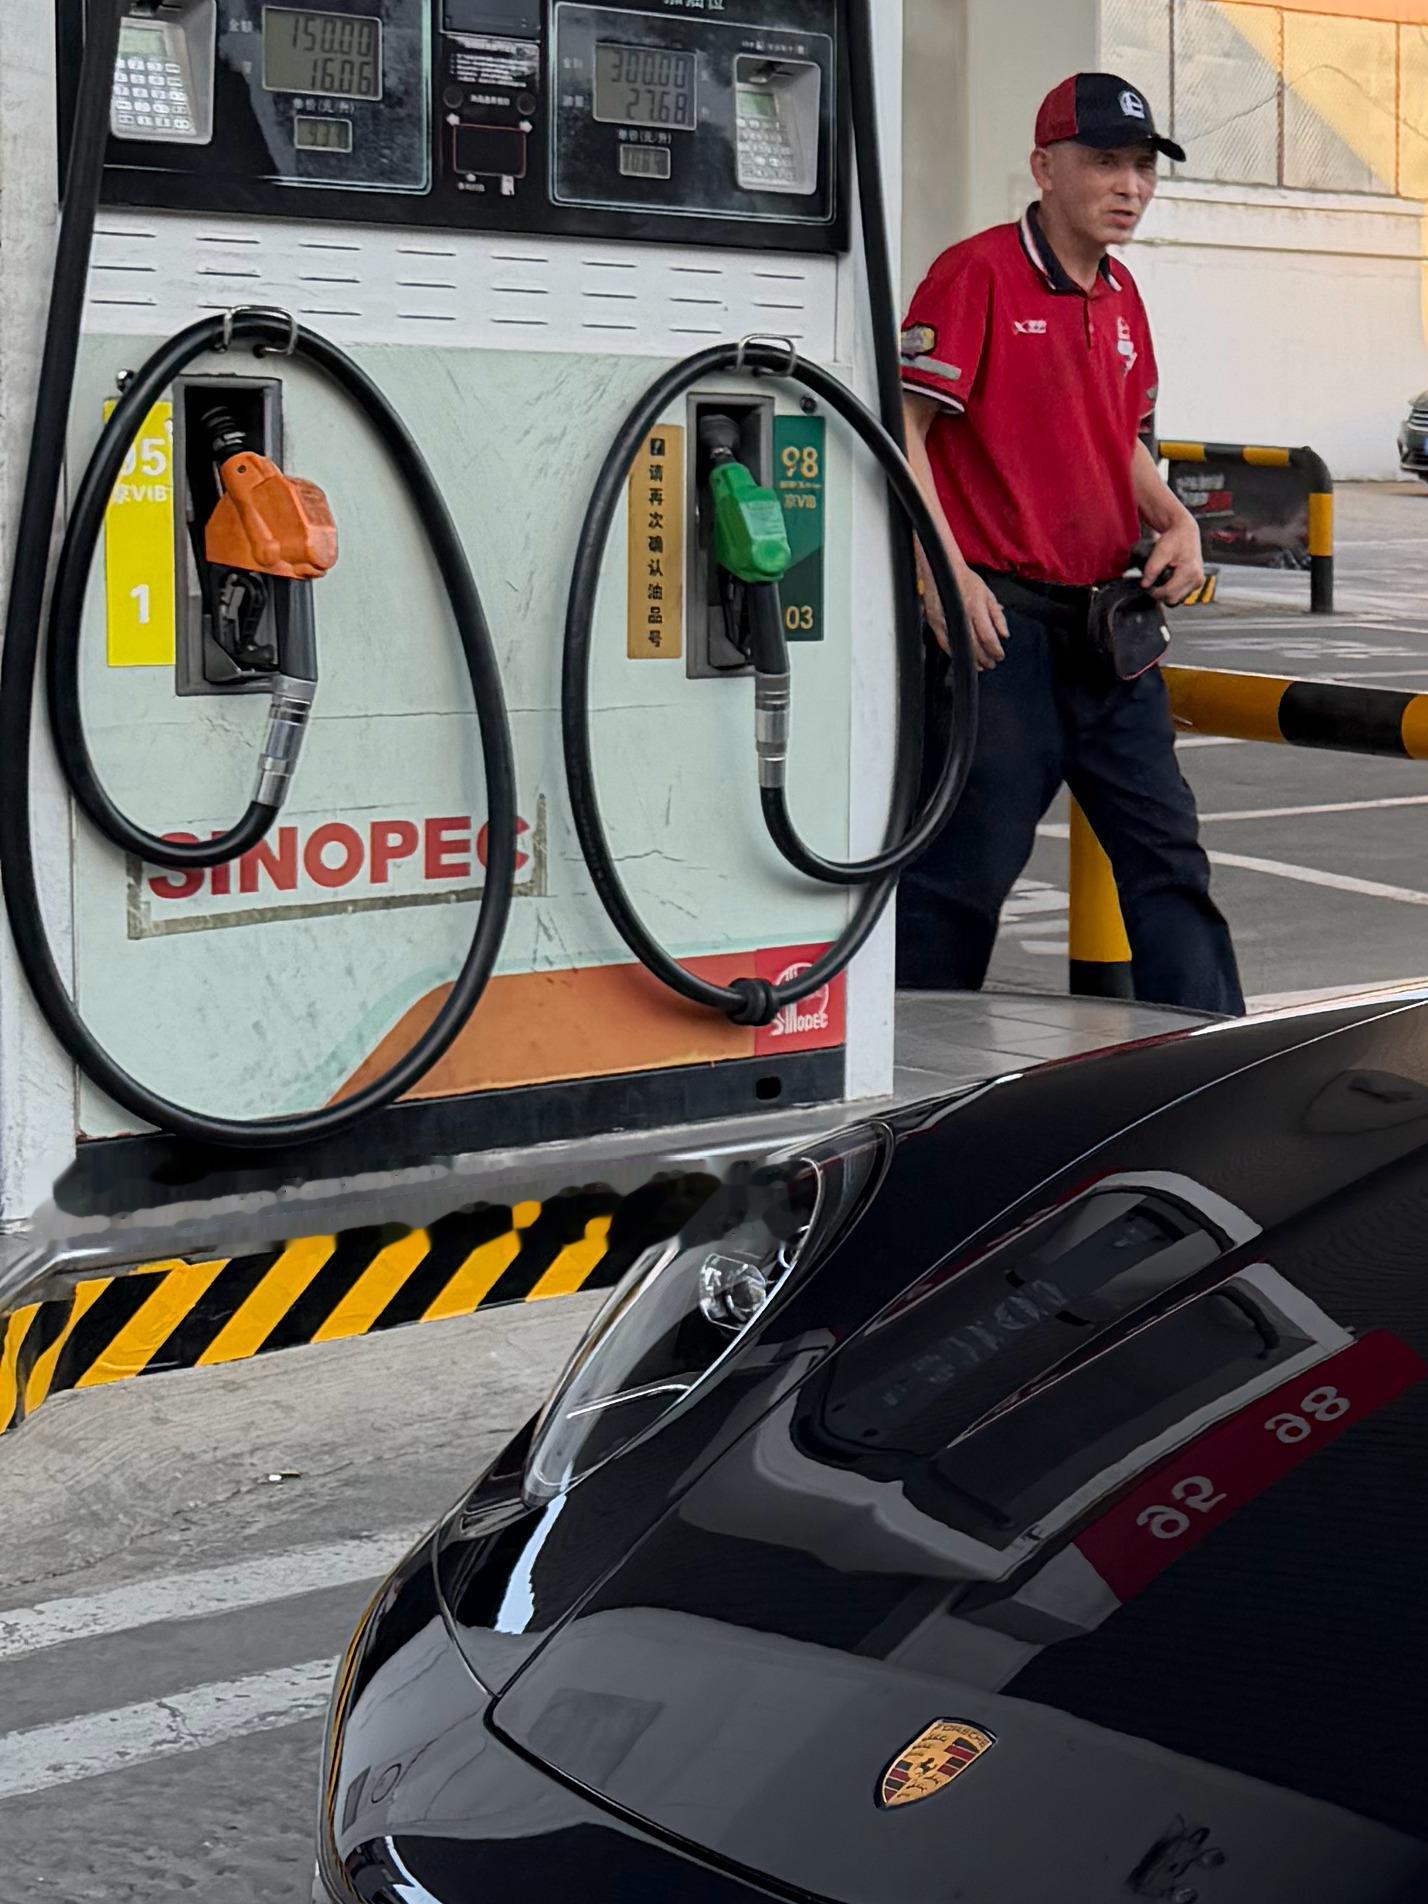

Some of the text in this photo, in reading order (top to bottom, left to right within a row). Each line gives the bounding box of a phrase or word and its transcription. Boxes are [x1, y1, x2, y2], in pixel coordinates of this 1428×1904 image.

[782, 446, 818, 479] 98
[647, 463, 664, 648] 请再次确认油品号
[130, 584, 151, 625] 1
[785, 605, 814, 629] 03
